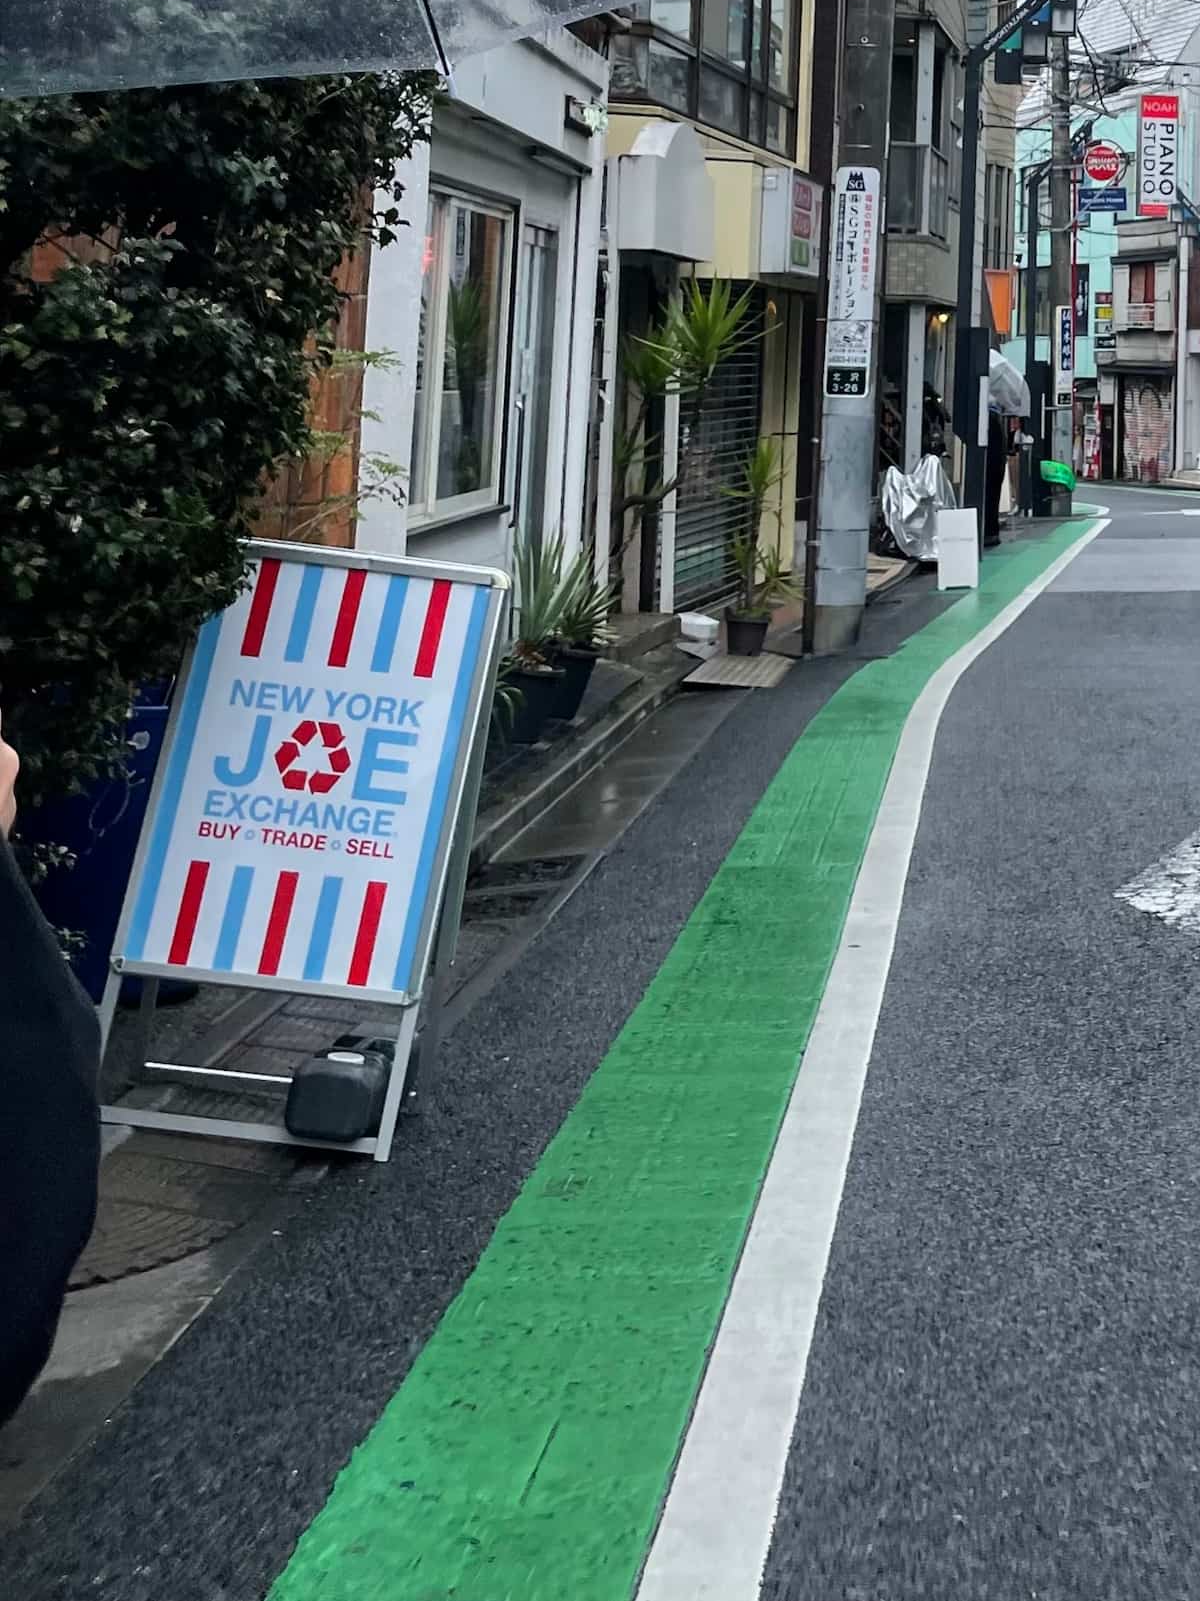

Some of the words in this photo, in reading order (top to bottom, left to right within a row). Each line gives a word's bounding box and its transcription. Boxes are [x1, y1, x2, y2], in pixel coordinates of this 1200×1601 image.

[1143, 102, 1176, 113] NOAH
[1143, 122, 1156, 194] STUDIO
[1159, 123, 1174, 196] PIANO
[848, 180, 864, 190] SG
[832, 383, 859, 393] 3-26
[229, 679, 315, 714] NEW
[325, 690, 424, 727] YORK
[203, 790, 395, 837] EXCHANGE
[198, 821, 241, 841] BUY
[260, 828, 327, 850] TRADE
[345, 839, 394, 859] SELL
